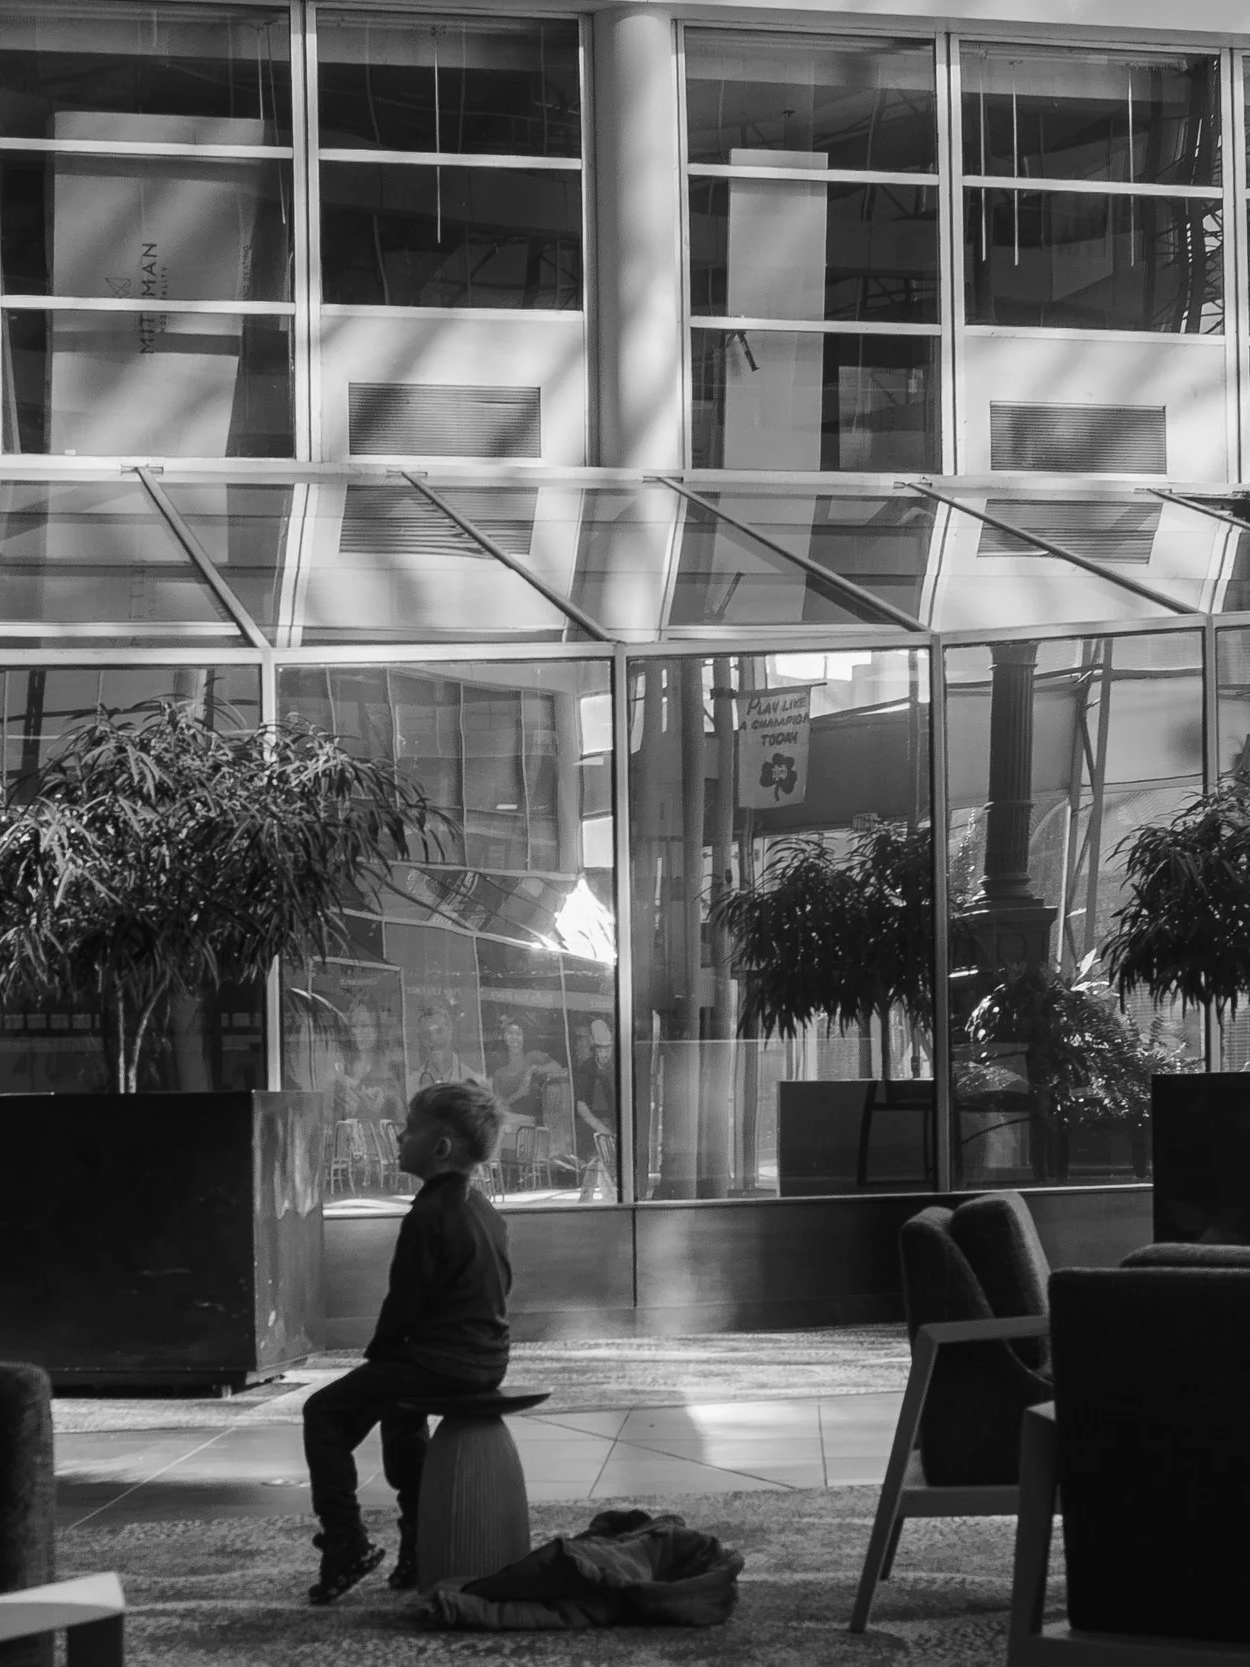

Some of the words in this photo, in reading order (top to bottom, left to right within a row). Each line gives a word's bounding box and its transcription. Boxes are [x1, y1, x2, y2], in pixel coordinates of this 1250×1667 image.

[140, 243, 157, 354] MITMAN
[747, 697, 779, 716] PLAY
[782, 697, 806, 712] LIKE
[739, 721, 747, 731] A
[761, 731, 798, 747] TODAY
